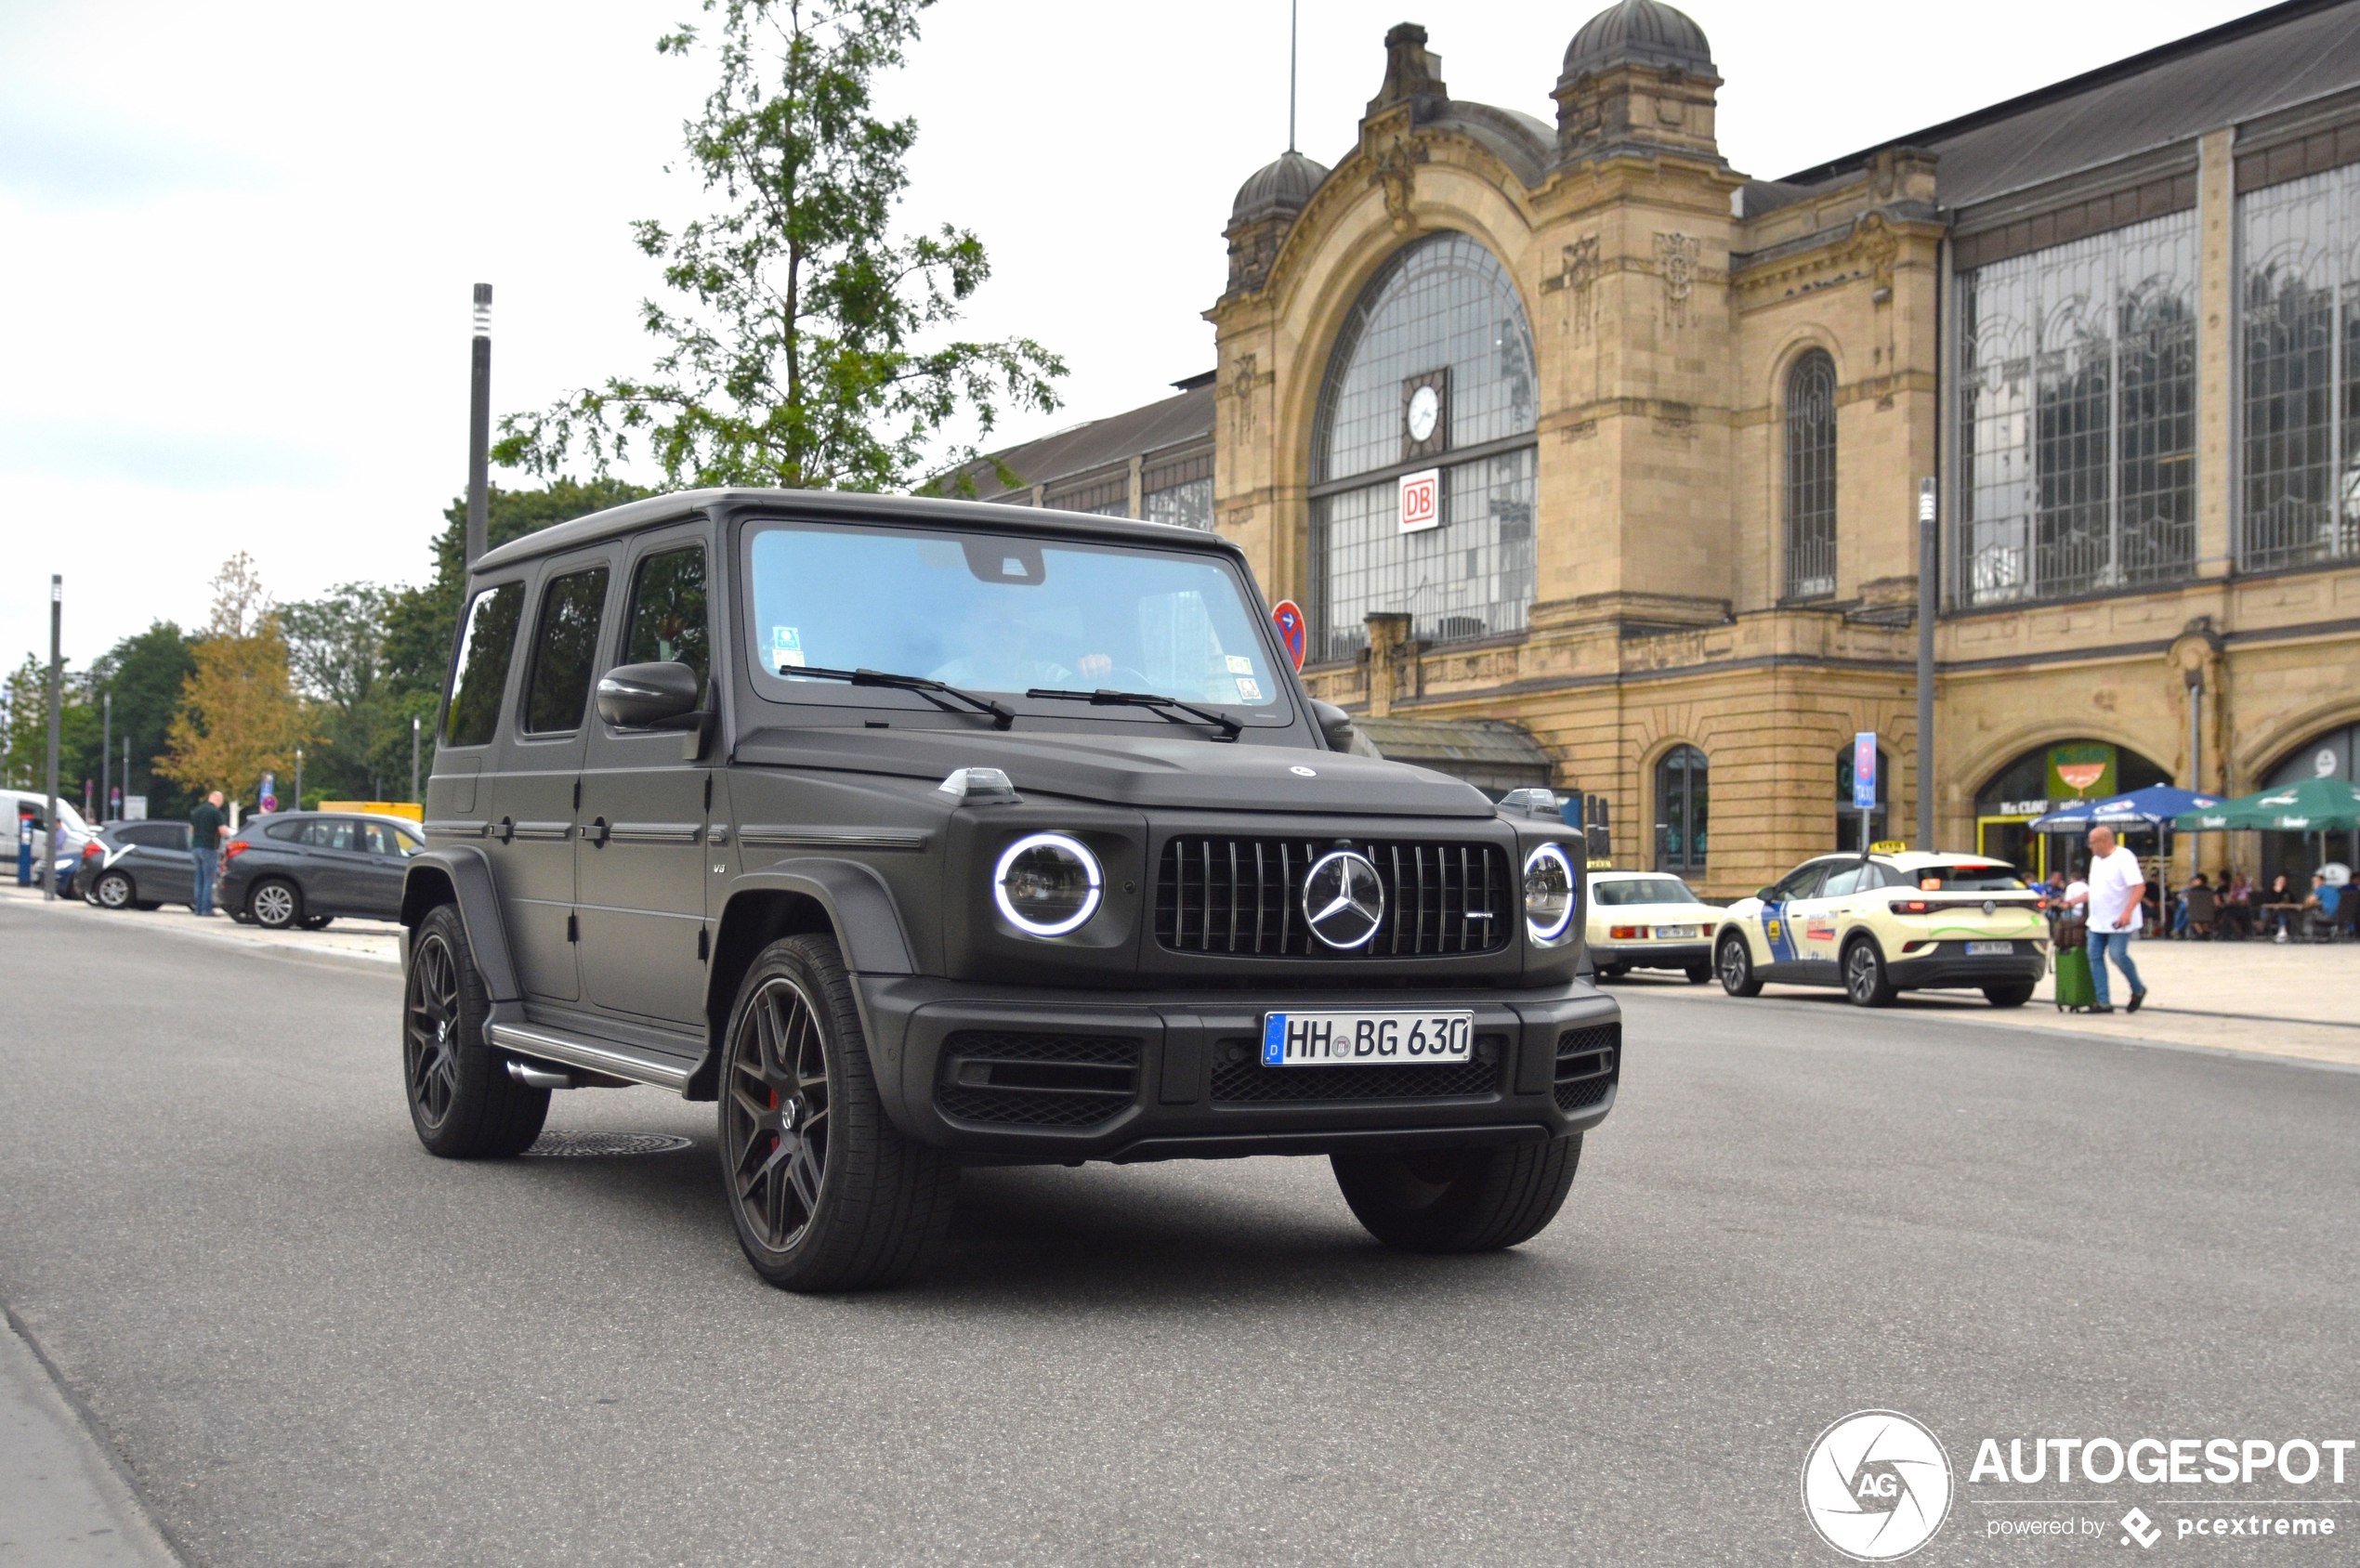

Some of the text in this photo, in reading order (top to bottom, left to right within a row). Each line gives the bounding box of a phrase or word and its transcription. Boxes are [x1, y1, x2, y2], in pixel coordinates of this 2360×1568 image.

[1408, 486, 1431, 516] DB
[1855, 784, 1873, 802] TAXI
[714, 864, 726, 873] V8
[1286, 1016, 1469, 1058] HH BG 630
[1269, 1044, 1278, 1056] D
